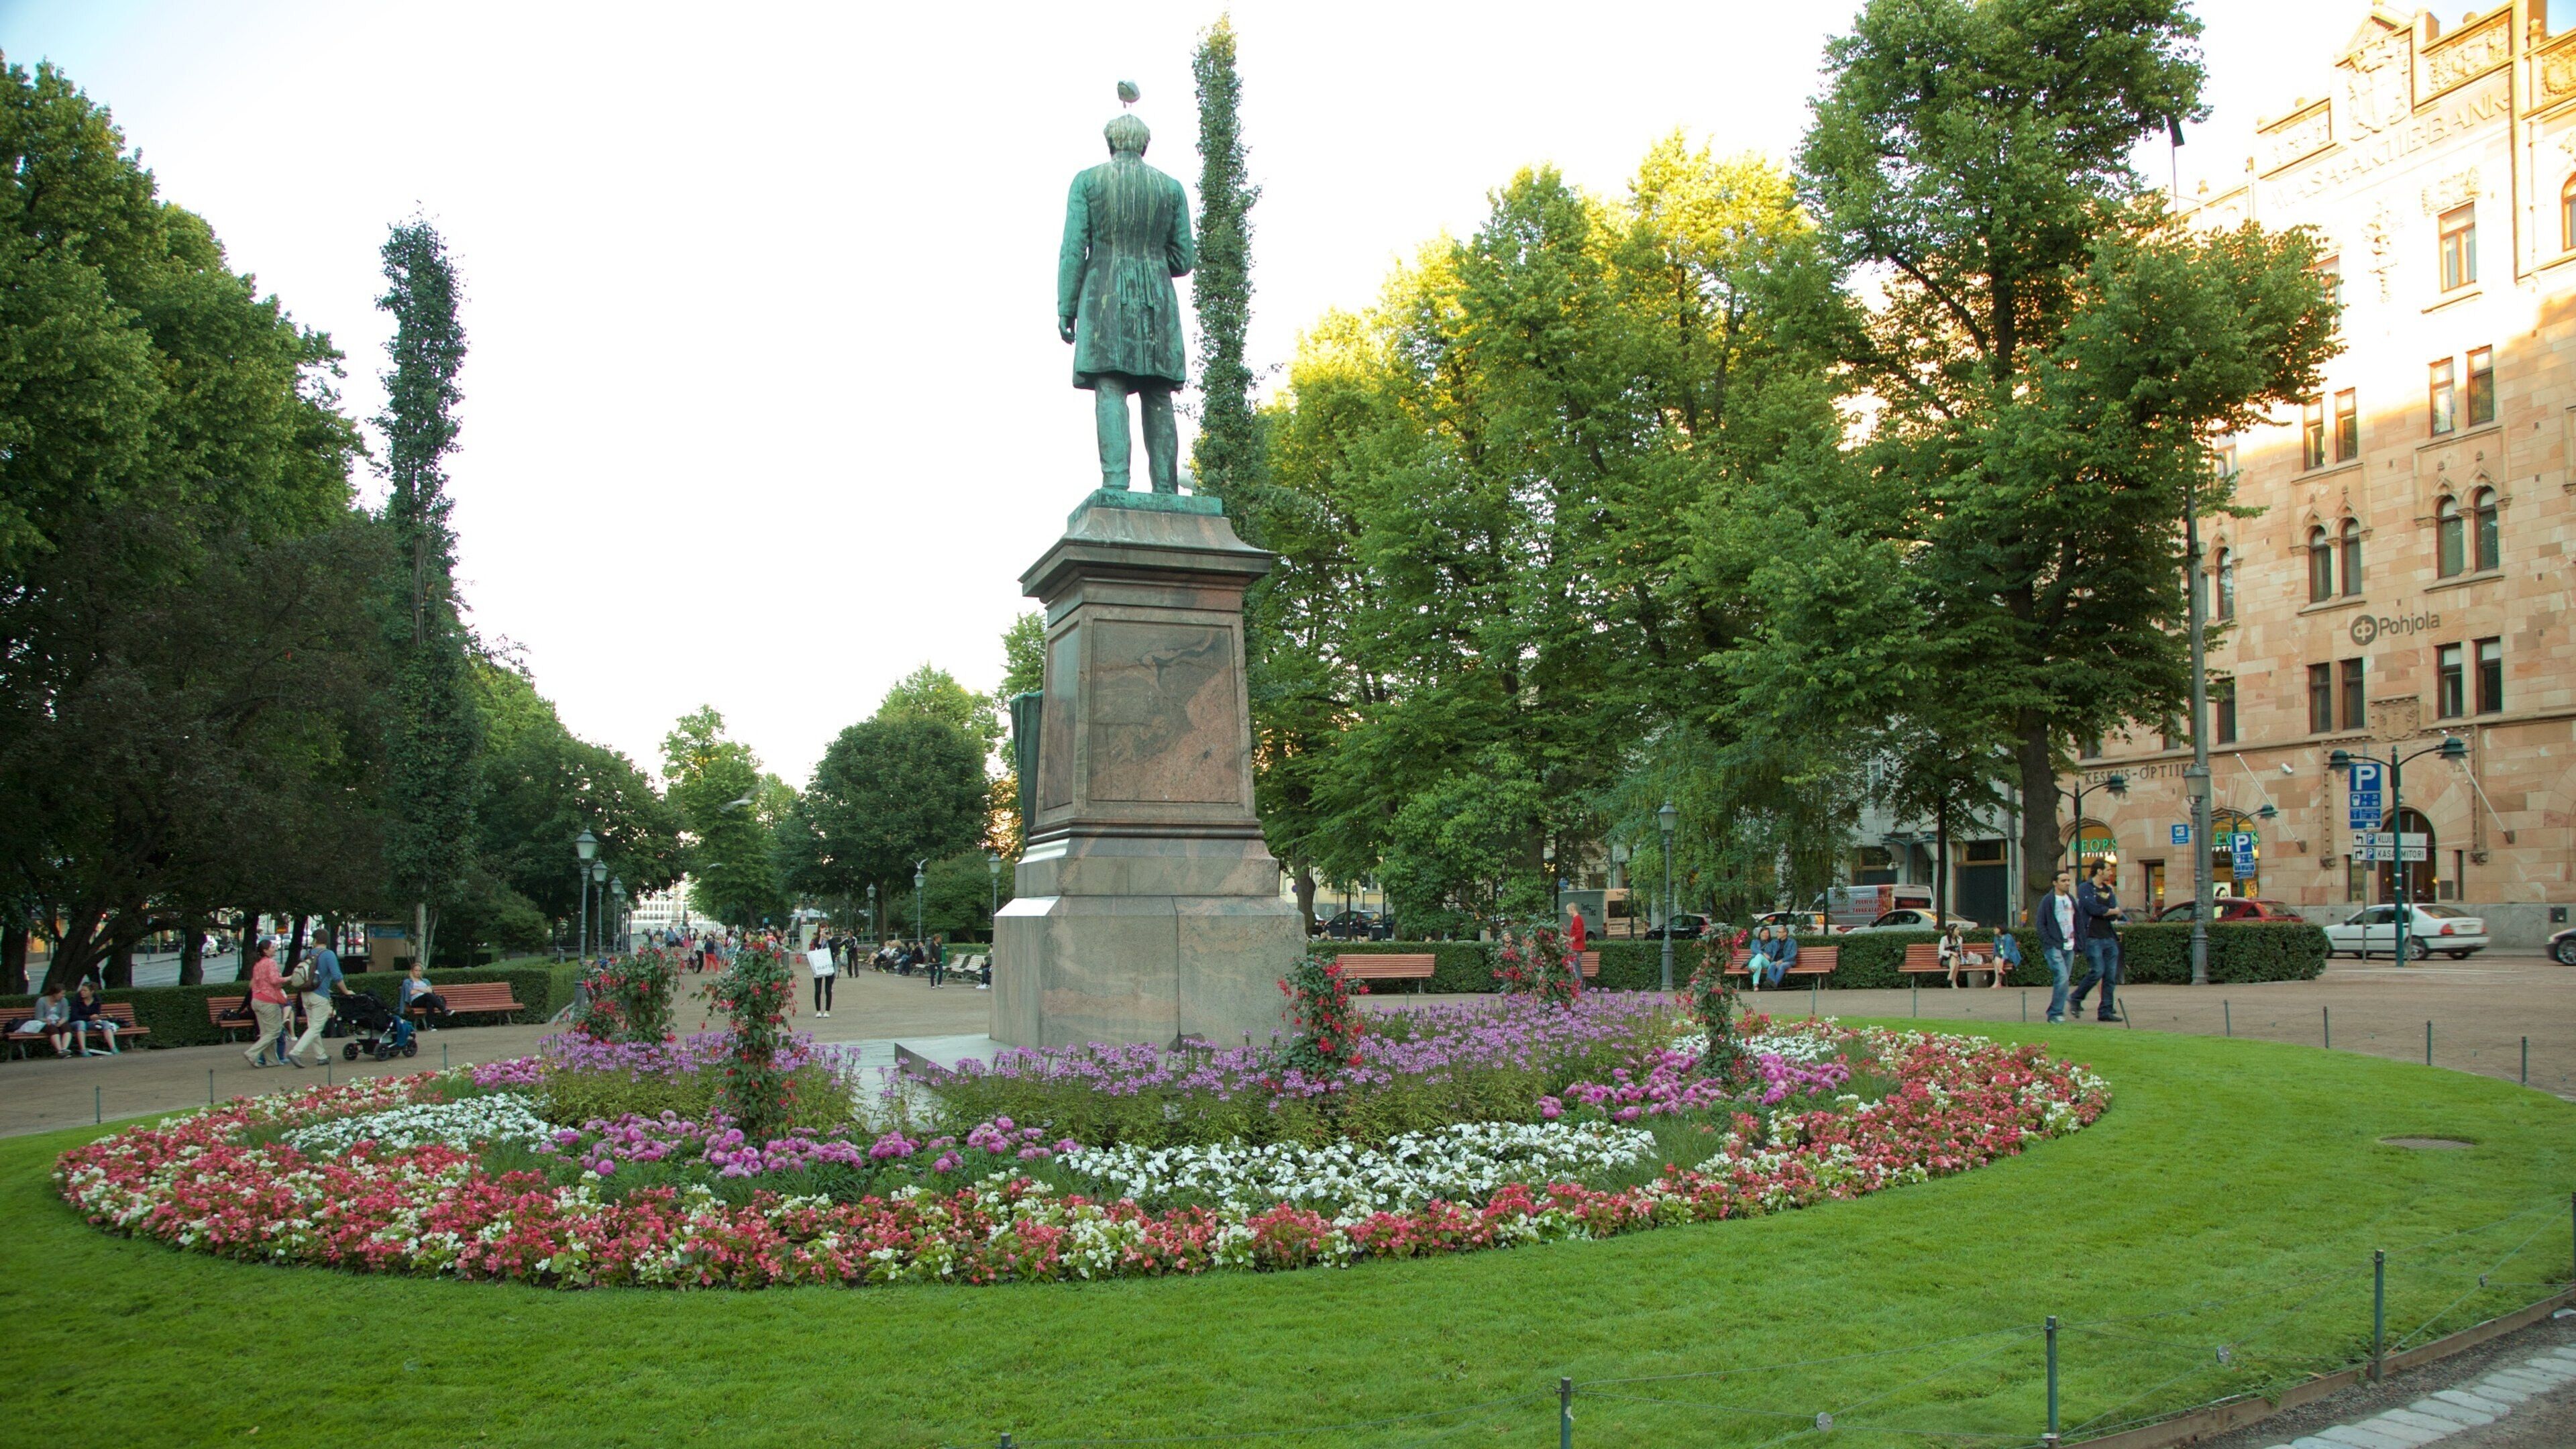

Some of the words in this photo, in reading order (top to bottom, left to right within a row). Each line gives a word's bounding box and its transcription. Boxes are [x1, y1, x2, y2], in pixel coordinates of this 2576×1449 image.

[2379, 610, 2441, 637] Pohjola
[2356, 765, 2376, 790] P
[2235, 835, 2249, 853] P
[2378, 849, 2424, 859] KASAMITORI
